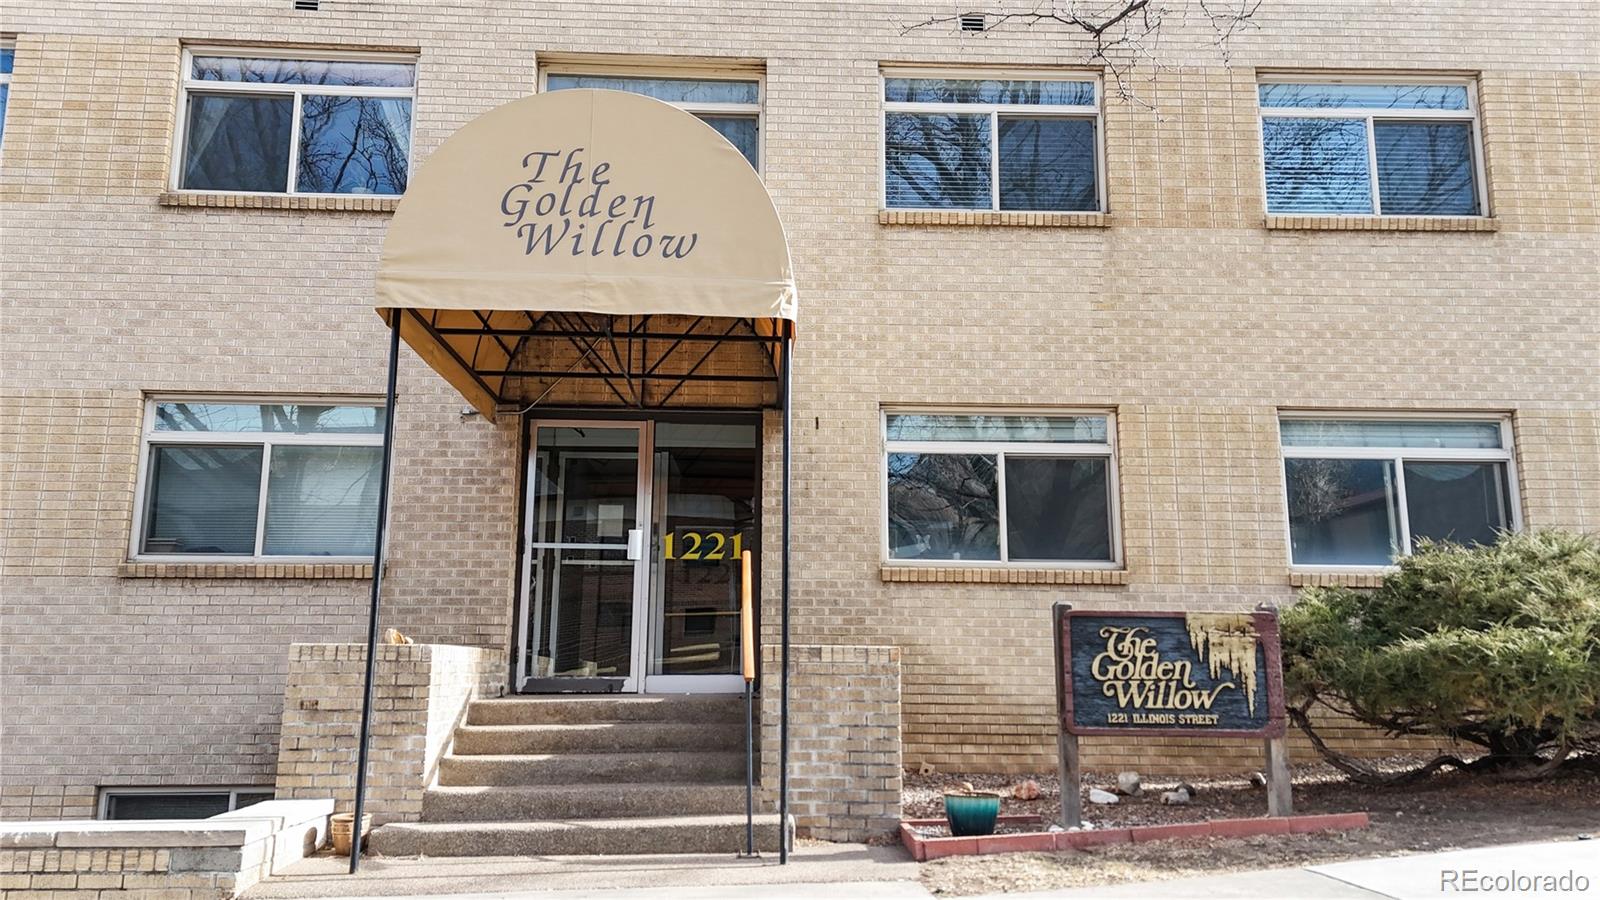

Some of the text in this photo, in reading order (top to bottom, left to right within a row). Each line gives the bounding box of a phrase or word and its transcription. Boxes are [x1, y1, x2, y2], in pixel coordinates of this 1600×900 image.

[522, 148, 610, 185] The
[500, 182, 655, 230] Golden
[517, 218, 698, 259] Willow
[663, 532, 743, 560] 1221
[1100, 626, 1158, 662] The
[1091, 650, 1196, 688] Golden
[1103, 680, 1235, 710] Willow
[1107, 713, 1219, 725] 1221 ILLINOIS STREET
